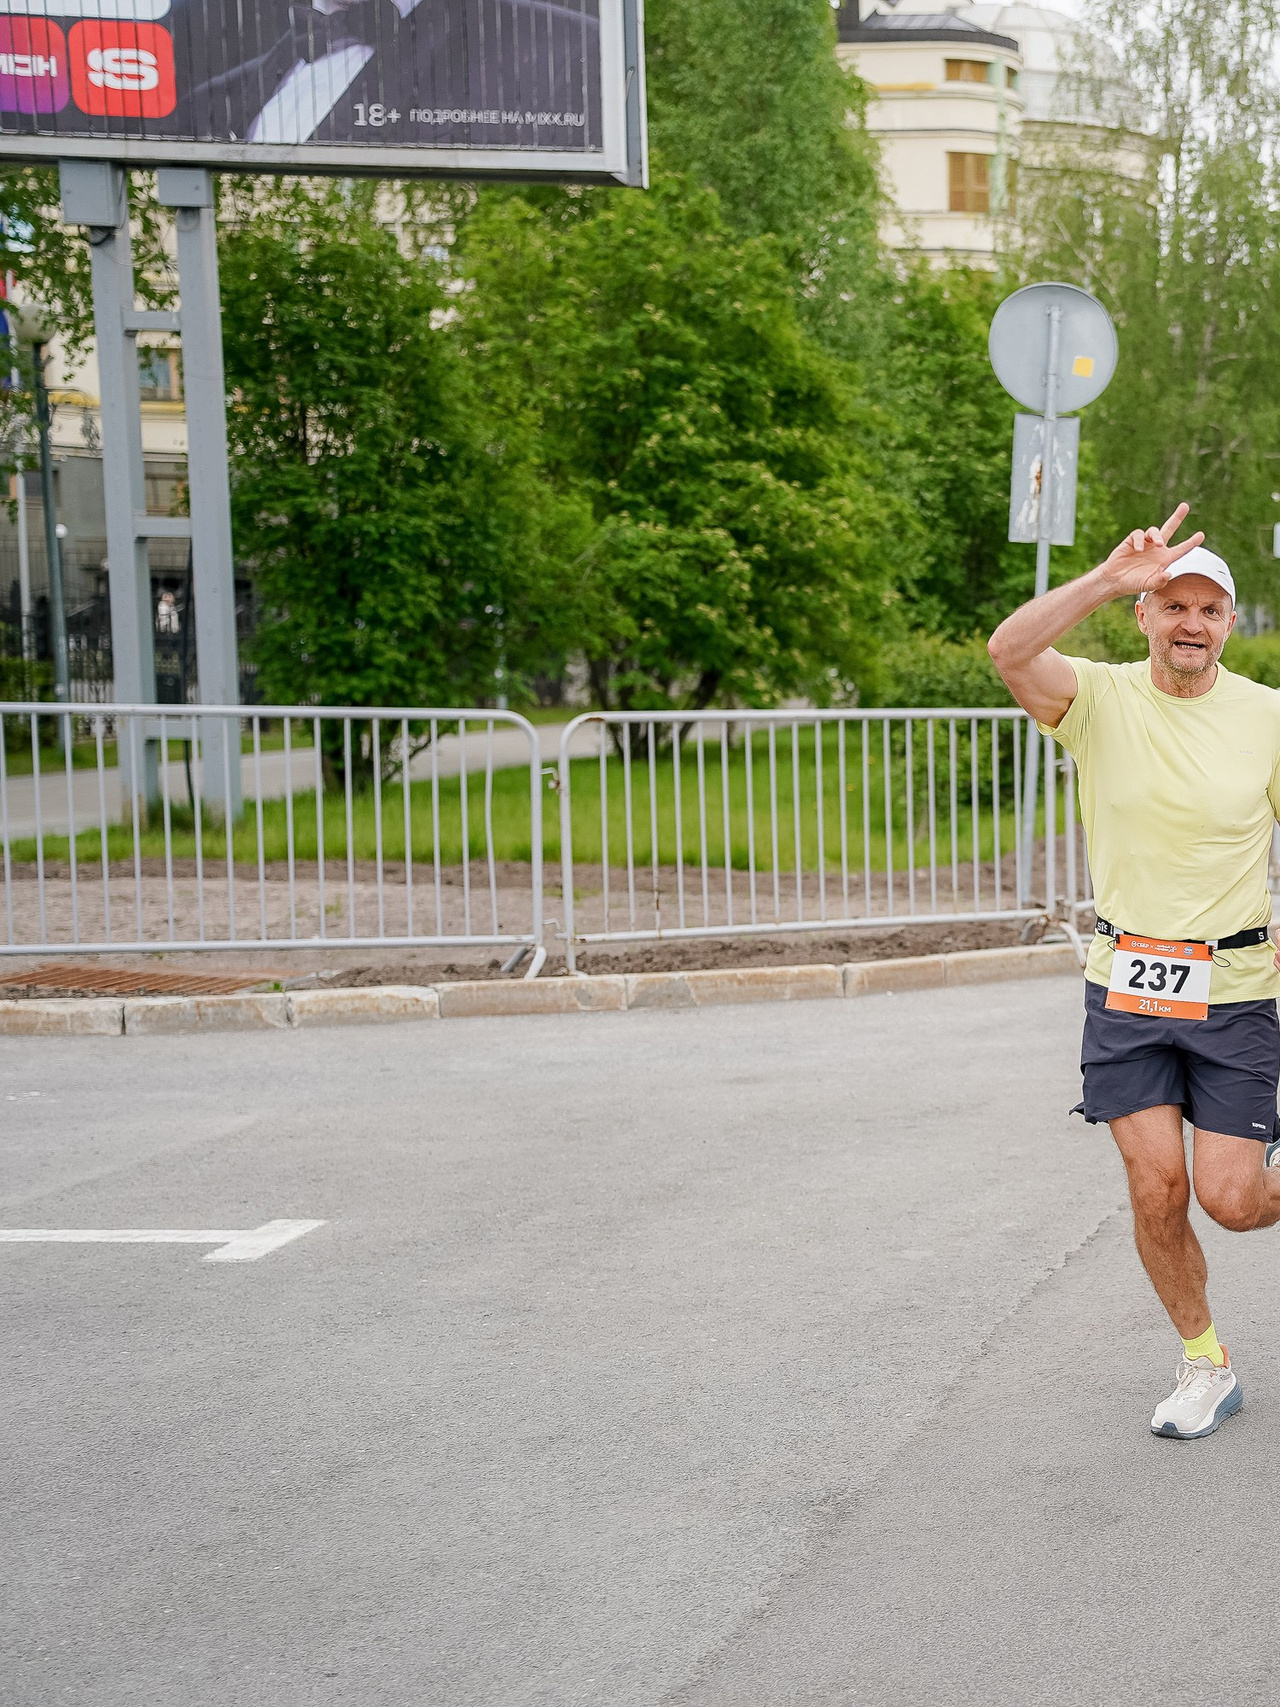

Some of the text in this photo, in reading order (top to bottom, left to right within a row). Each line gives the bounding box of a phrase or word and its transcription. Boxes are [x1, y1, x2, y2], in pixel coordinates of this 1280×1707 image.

[353, 102, 401, 127] 18+
[409, 108, 501, 125] ПОДРОБНЕЕ
[501, 110, 525, 125] НА
[1128, 959, 1191, 994] 237
